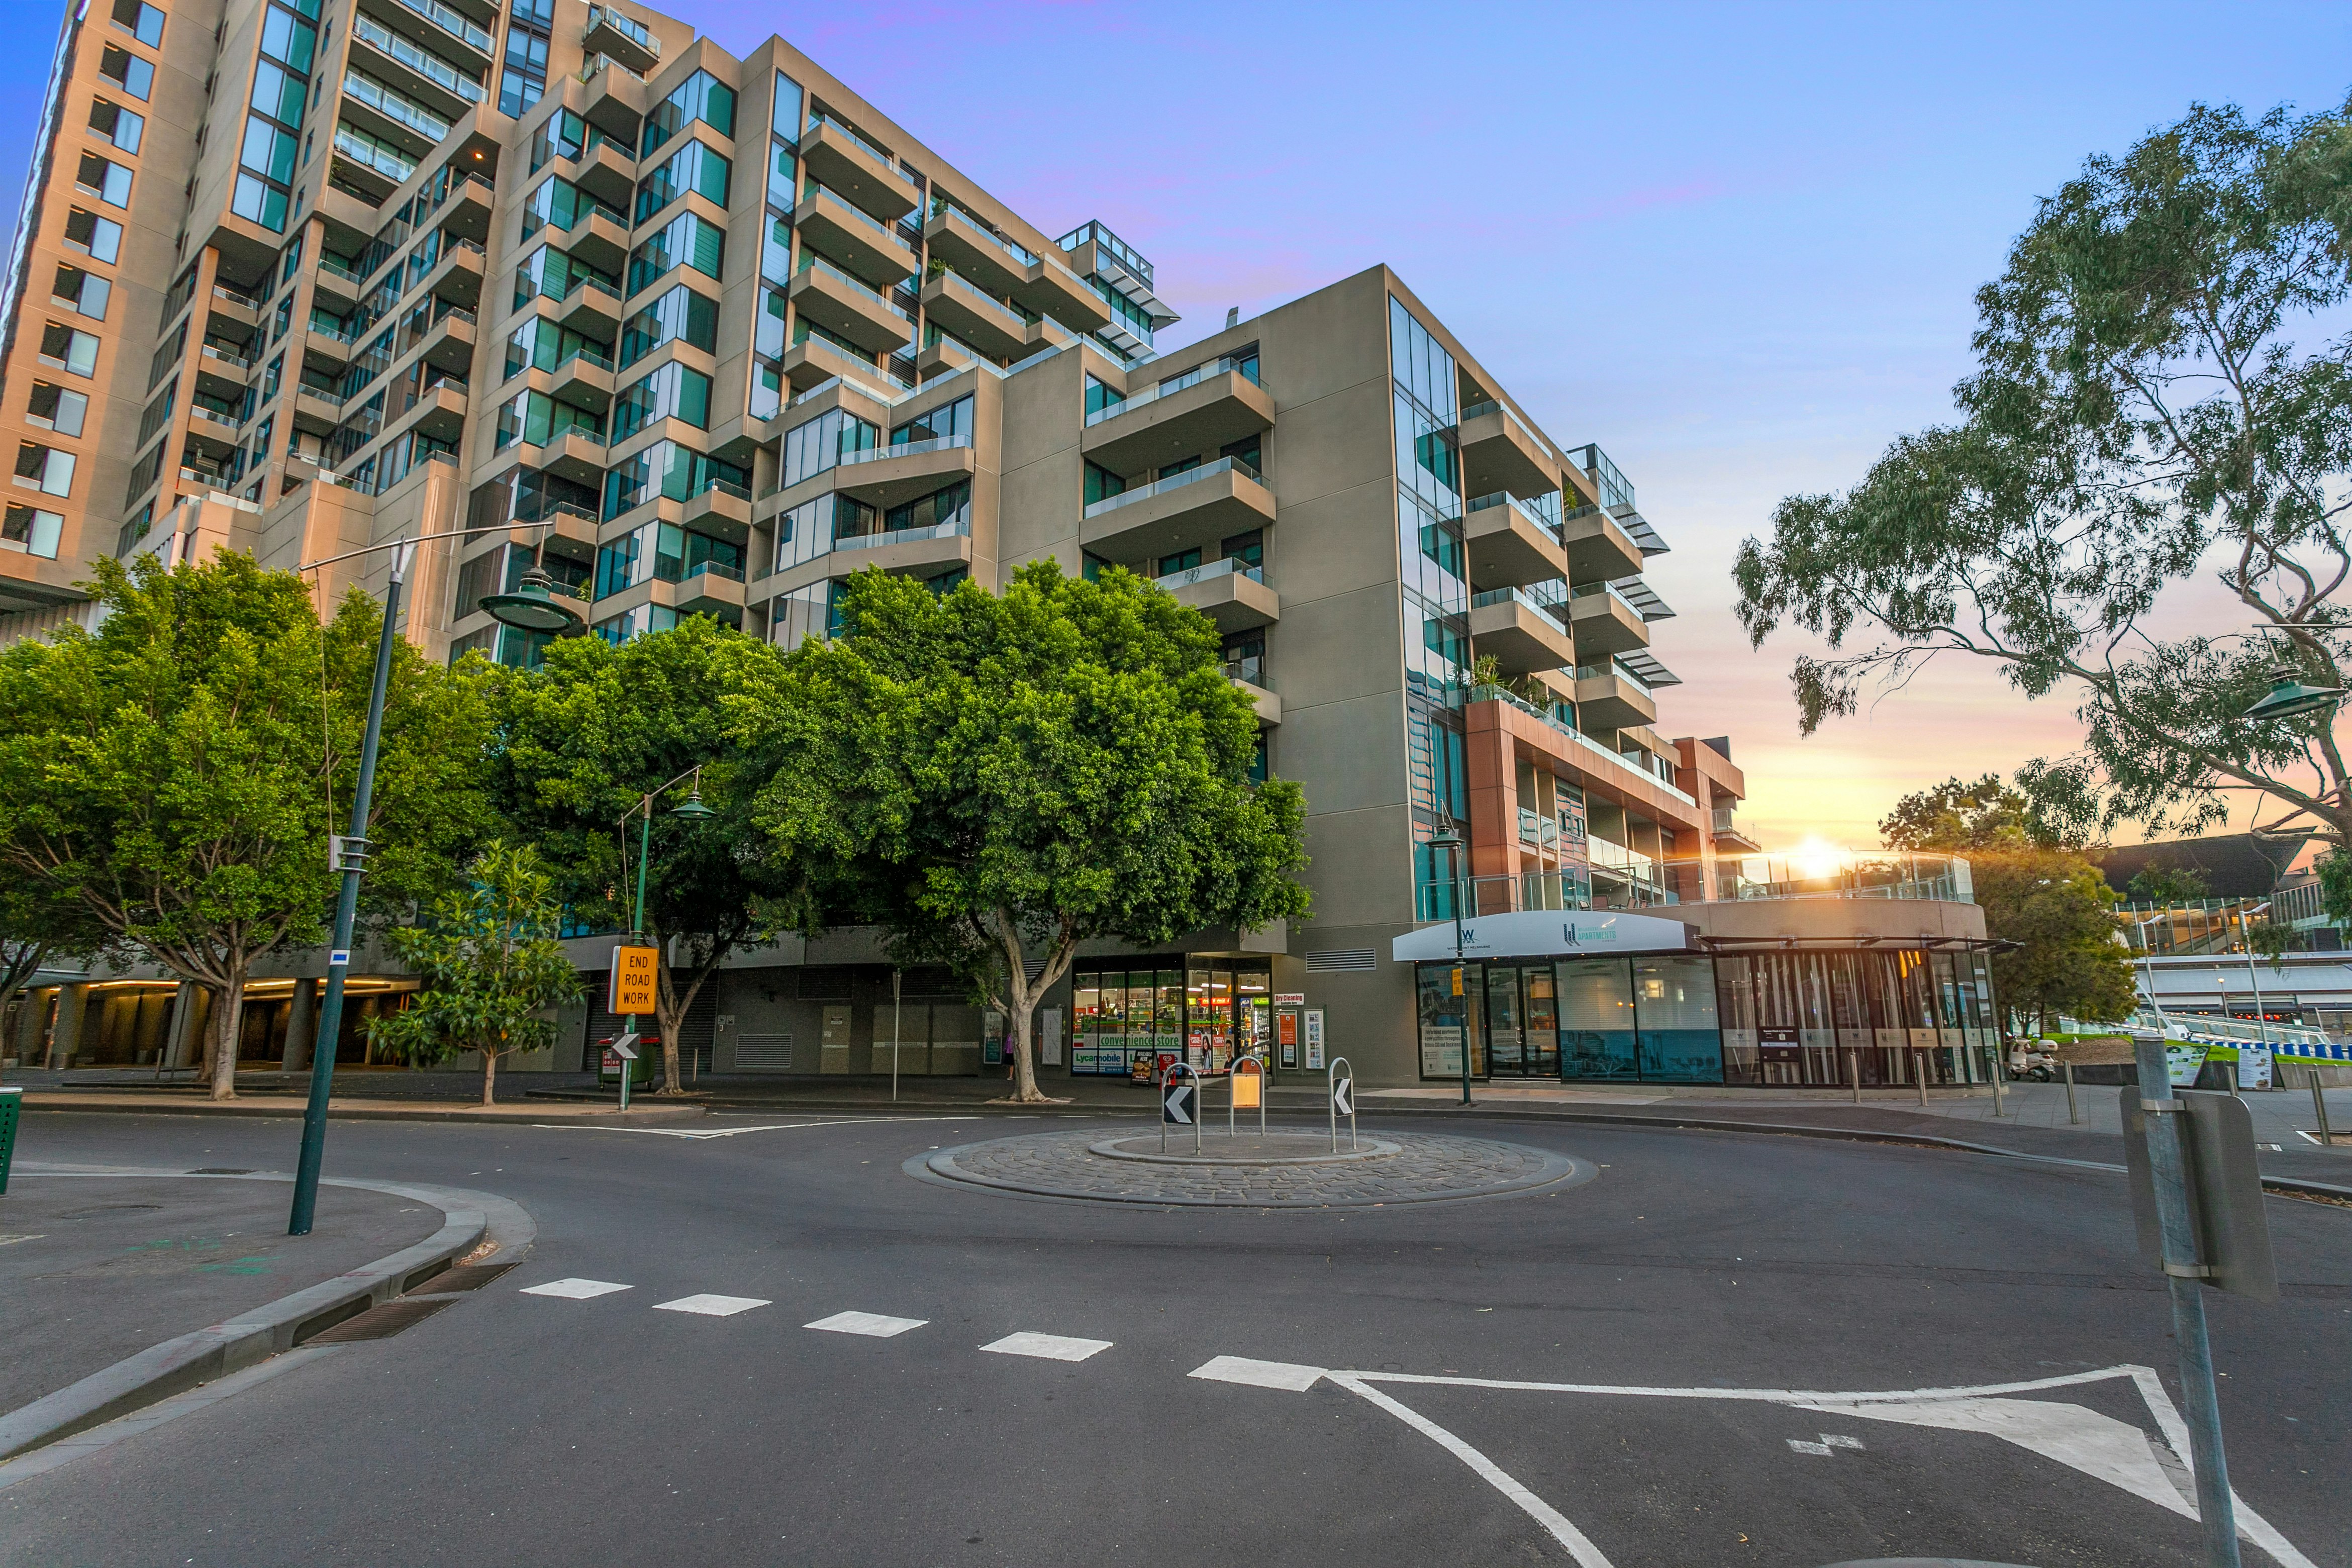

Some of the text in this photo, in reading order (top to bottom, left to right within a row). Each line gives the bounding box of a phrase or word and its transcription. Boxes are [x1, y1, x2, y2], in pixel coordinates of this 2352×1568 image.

[1578, 931, 1616, 940] APARTMENTS
[630, 956, 648, 968] END
[625, 974, 649, 986] ROAD
[624, 992, 649, 1004] WORK
[1101, 1034, 1153, 1045] convenience
[1157, 1035, 1179, 1045] store
[1076, 1053, 1121, 1063] Lycamobile
